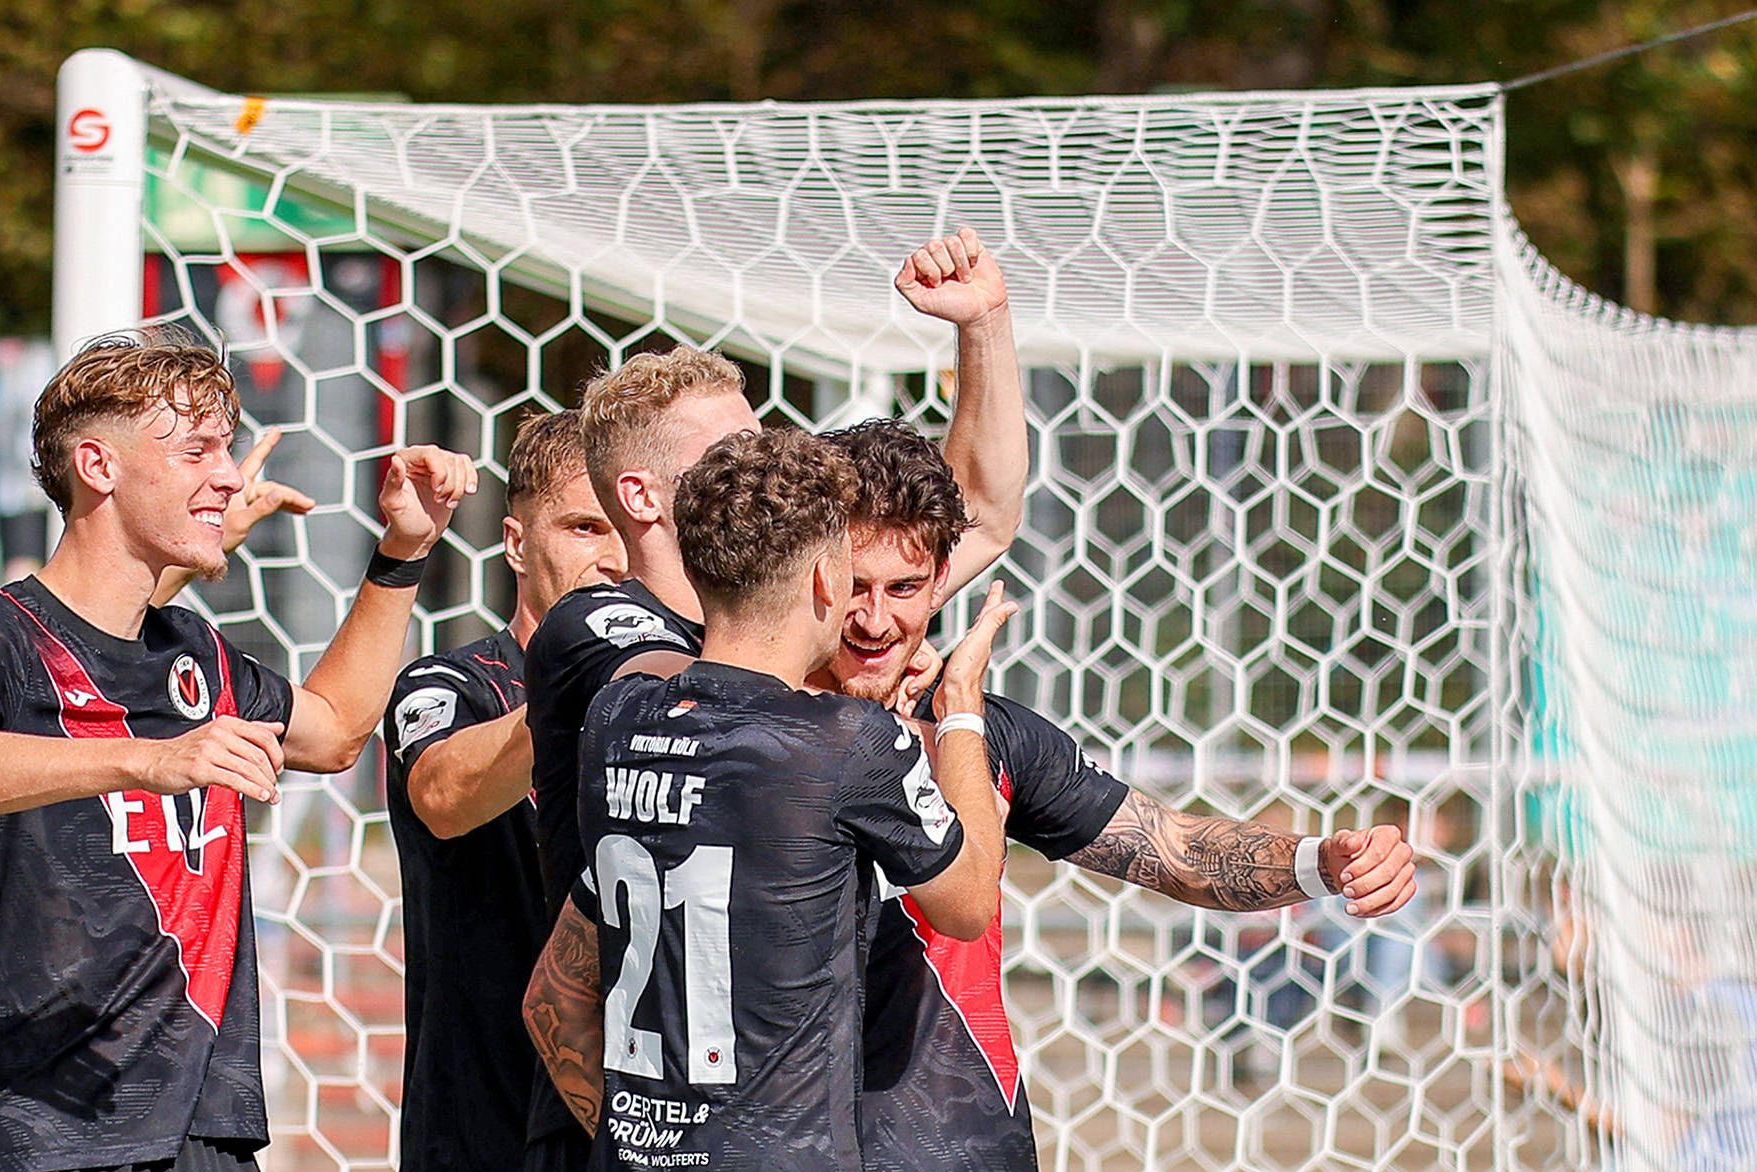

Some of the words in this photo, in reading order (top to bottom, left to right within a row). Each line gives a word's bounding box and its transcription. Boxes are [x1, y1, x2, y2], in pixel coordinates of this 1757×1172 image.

[605, 766, 707, 825] WOLF
[596, 834, 738, 1084] 21
[611, 1091, 691, 1124] OERTEL
[692, 1103, 710, 1124] &
